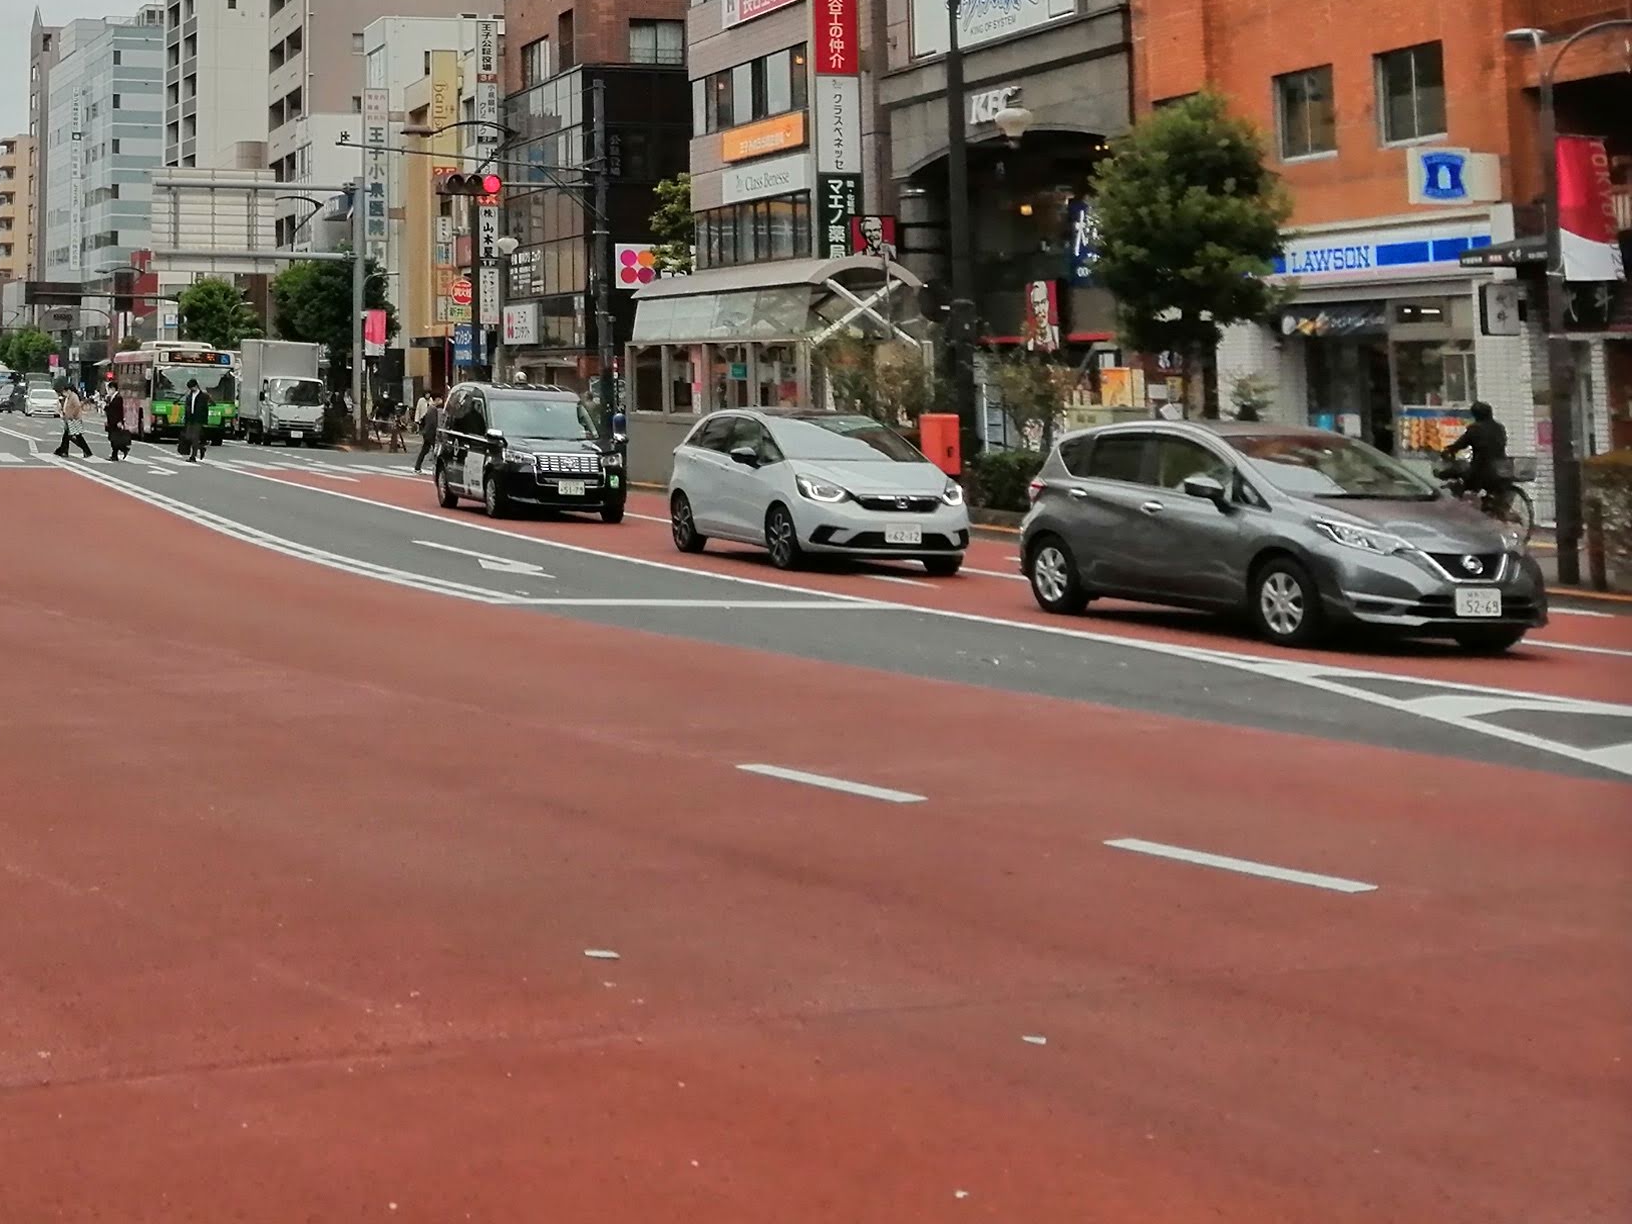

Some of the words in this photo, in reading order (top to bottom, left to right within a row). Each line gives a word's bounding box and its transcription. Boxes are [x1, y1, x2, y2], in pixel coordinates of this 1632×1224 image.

[993, 13, 1016, 30] SYSTEM
[478, 101, 488, 136] クリニク
[970, 86, 1023, 125] KFC
[832, 93, 845, 171] クラスベネッセ
[368, 126, 385, 237] 王子小泉医院
[827, 179, 846, 259] マエノ薬局
[1291, 245, 1371, 273] LAWSON
